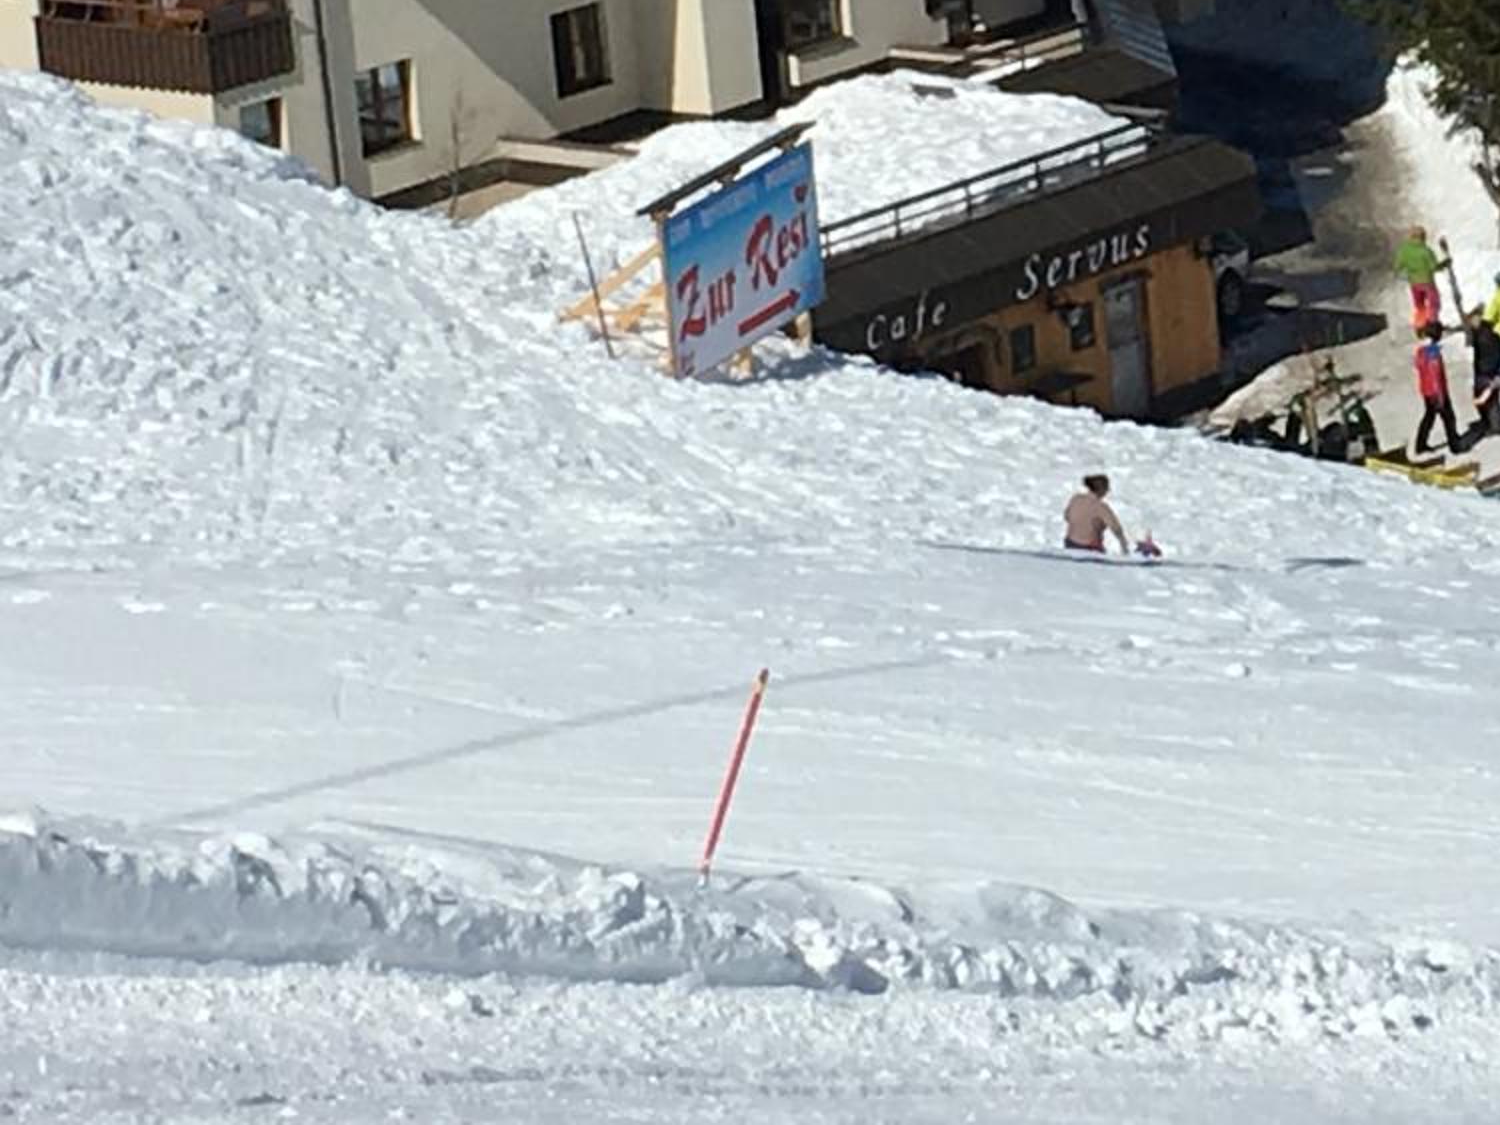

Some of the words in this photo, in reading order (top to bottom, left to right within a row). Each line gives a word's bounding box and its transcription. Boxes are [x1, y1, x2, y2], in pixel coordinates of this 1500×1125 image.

[676, 263, 736, 343] Zur
[866, 289, 947, 351] Cafe
[1015, 223, 1150, 301] Servus
